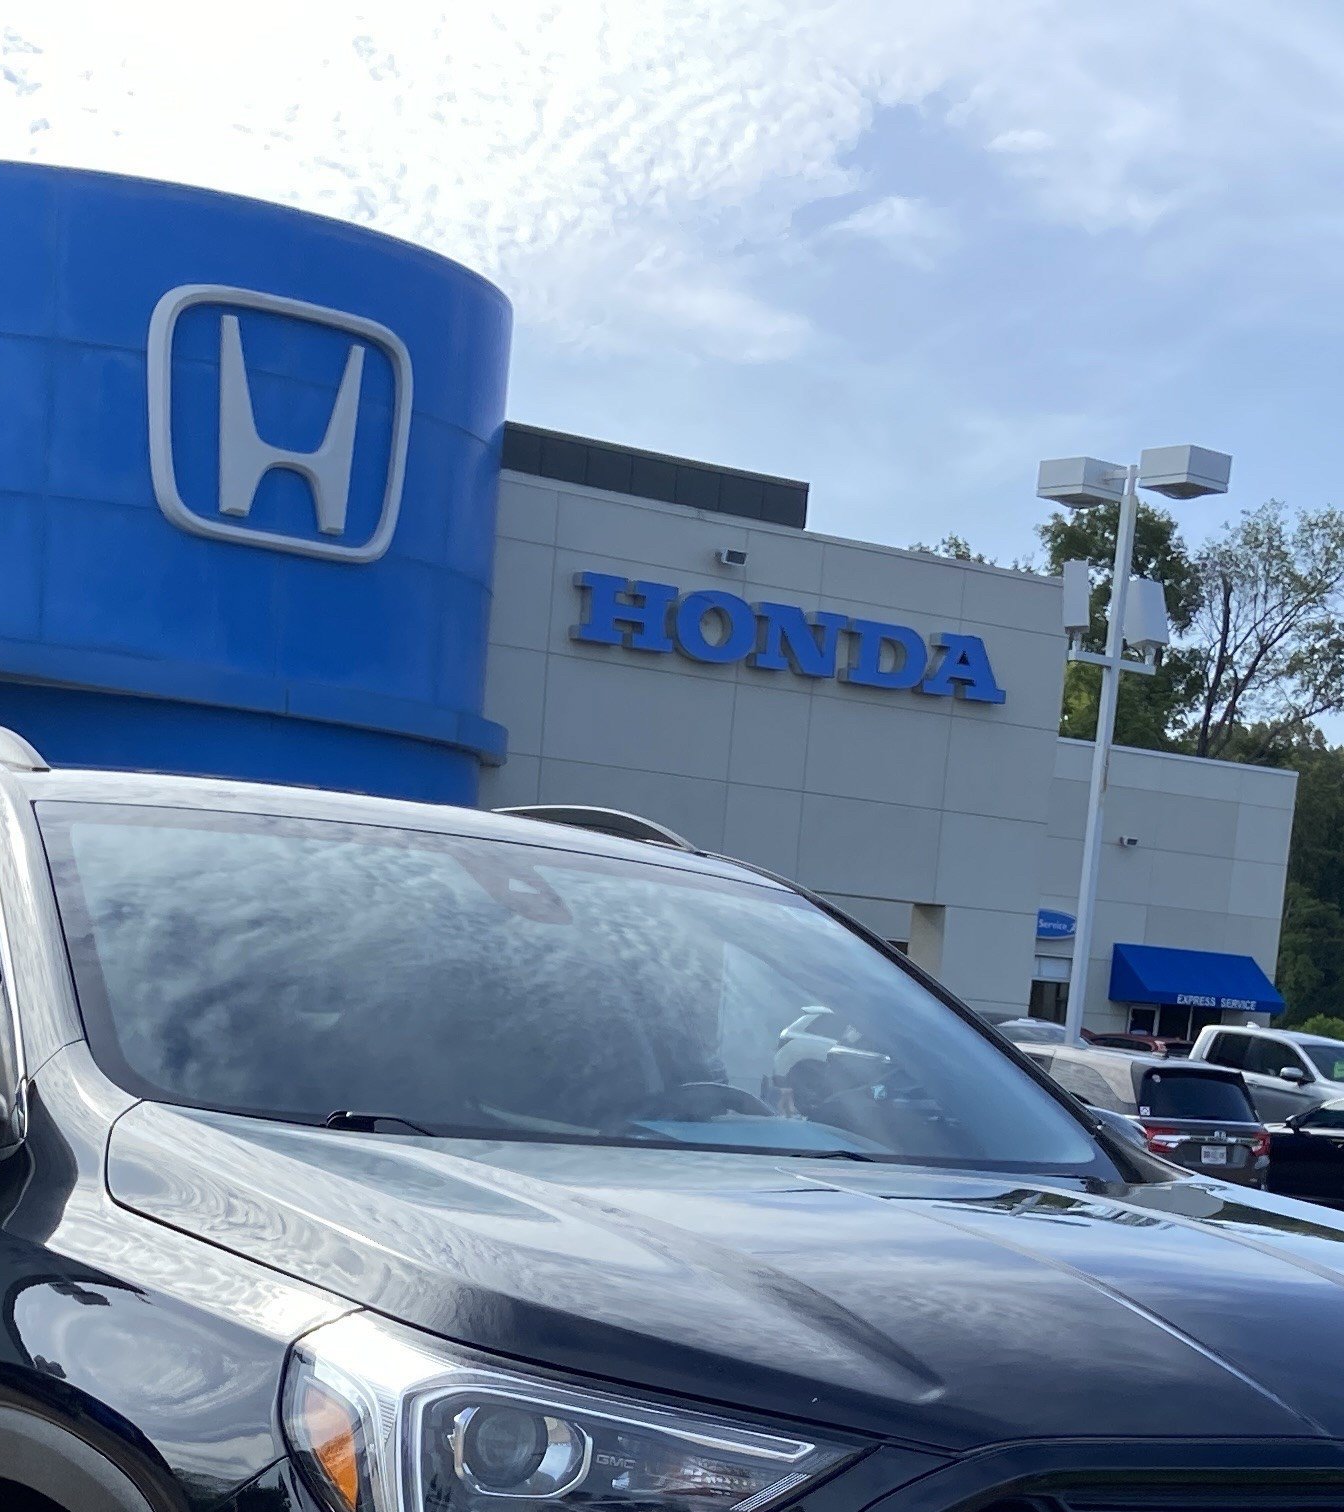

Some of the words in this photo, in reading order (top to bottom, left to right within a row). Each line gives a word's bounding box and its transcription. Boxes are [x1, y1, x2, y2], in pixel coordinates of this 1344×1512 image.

[568, 570, 1007, 705] HONDA
[1038, 918, 1068, 930] Service
[1177, 993, 1216, 1008] EXPRESS
[1220, 997, 1257, 1011] SERVICE
[596, 1454, 637, 1470] GMC
